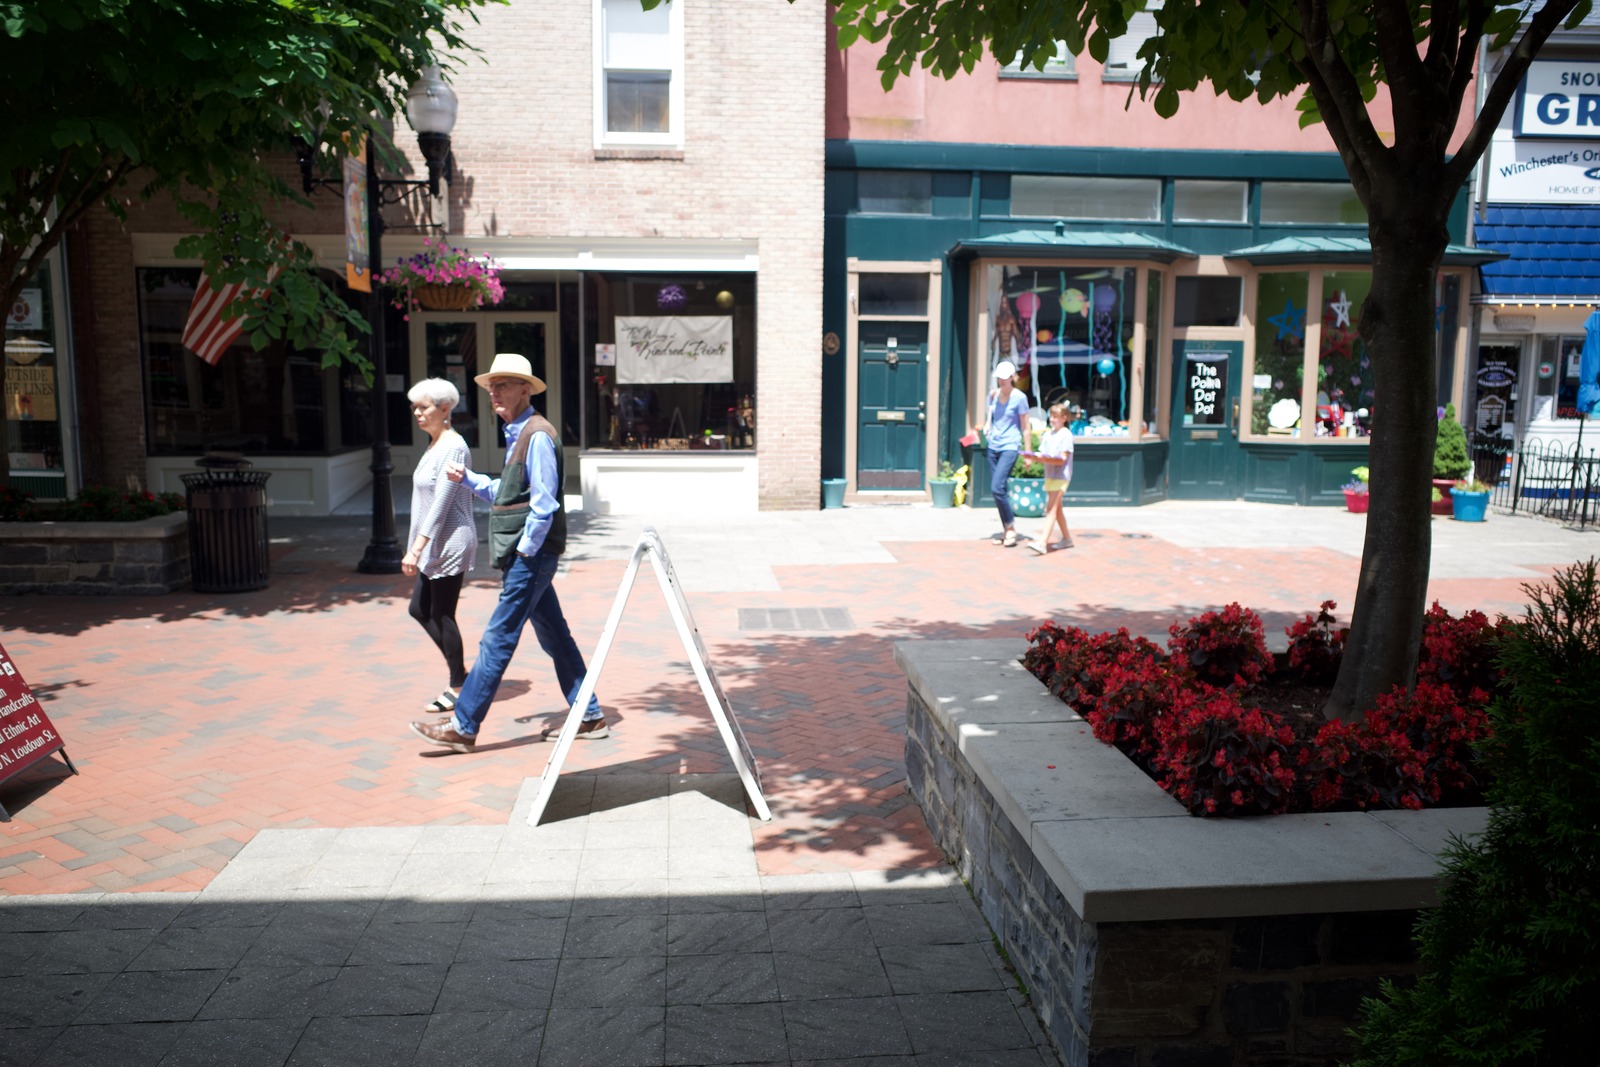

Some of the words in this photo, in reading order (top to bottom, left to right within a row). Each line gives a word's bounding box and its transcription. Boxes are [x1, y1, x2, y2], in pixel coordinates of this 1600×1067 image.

[1561, 72, 1600, 86] SNO
[1499, 151, 1579, 178] Winchester's
[1548, 186, 1580, 195] HOME
[1582, 186, 1597, 195] OF
[4, 368, 48, 381] UTSIDE
[1195, 362, 1217, 377] The
[4, 382, 20, 395] HE
[24, 382, 54, 395] LINES
[1191, 376, 1222, 390] Polka
[1194, 388, 1216, 402] Dot
[1194, 402, 1215, 415] Pot
[2, 720, 29, 740] Ethnic
[26, 713, 42, 728] Art
[11, 735, 46, 760] Loudoun
[42, 729, 57, 742] St.
